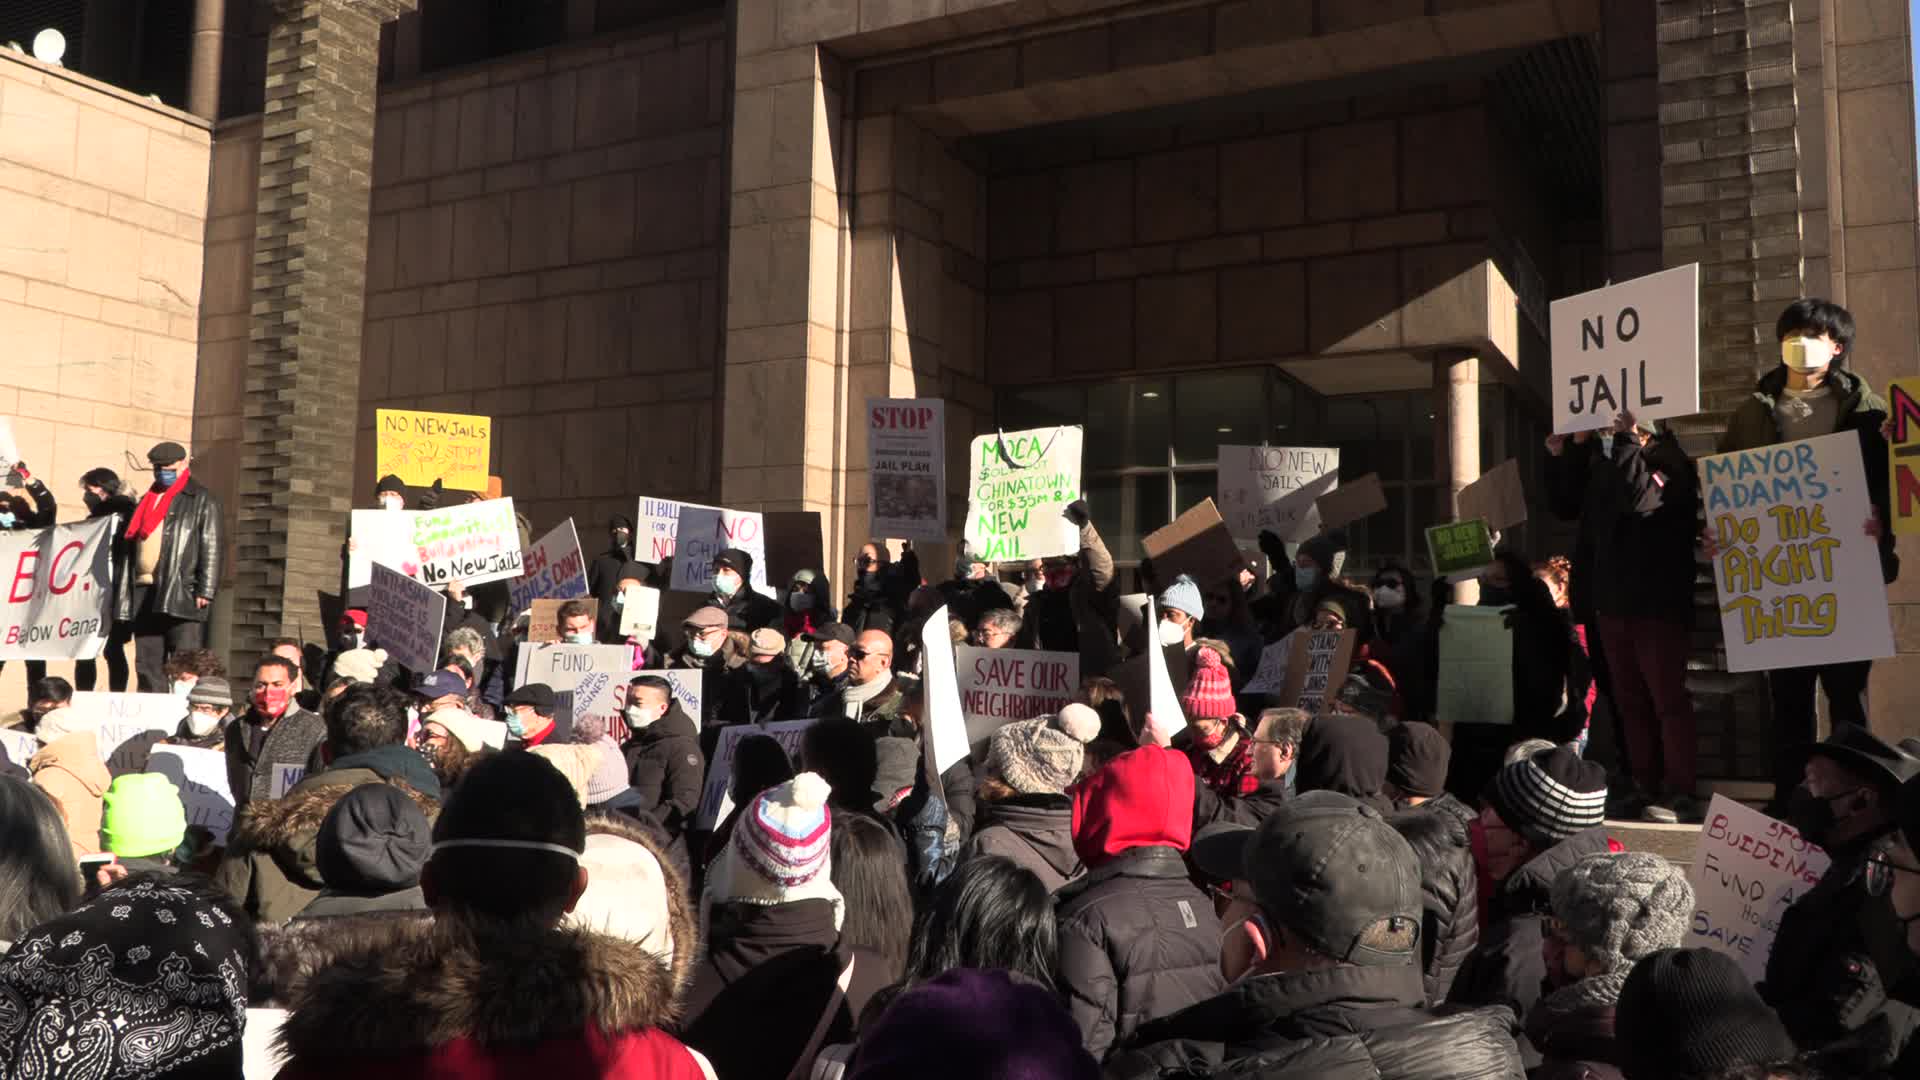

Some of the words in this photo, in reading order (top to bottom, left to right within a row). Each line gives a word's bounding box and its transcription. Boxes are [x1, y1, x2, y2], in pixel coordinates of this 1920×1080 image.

[1582, 307, 1640, 351] NO
[1568, 360, 1663, 415] JAIL
[385, 415, 409, 432] NO
[414, 416, 450, 435] NEW
[871, 407, 933, 431] STOP
[875, 461, 898, 472] JAIL
[901, 461, 930, 473] PLAN
[1248, 448, 1283, 472] NO
[1289, 449, 1328, 475] NEW
[1705, 443, 1818, 484] MAYOR
[976, 473, 1072, 501] CHINATOWN
[1053, 490, 1062, 502] &
[1263, 475, 1305, 491] JAILS
[1710, 472, 1842, 511] ADAMS:
[714, 516, 758, 542] NO
[978, 509, 1028, 536] NEW
[975, 536, 1025, 561] JAIL
[422, 563, 447, 583] No
[451, 558, 487, 577] New
[551, 652, 594, 673] FUND
[974, 657, 1025, 688] SAVE
[1031, 661, 1069, 692] OUR
[110, 698, 143, 718] NO
[574, 672, 609, 719] BUSINESS
[1702, 852, 1765, 901] FUND
[1692, 909, 1753, 953] SAVE
